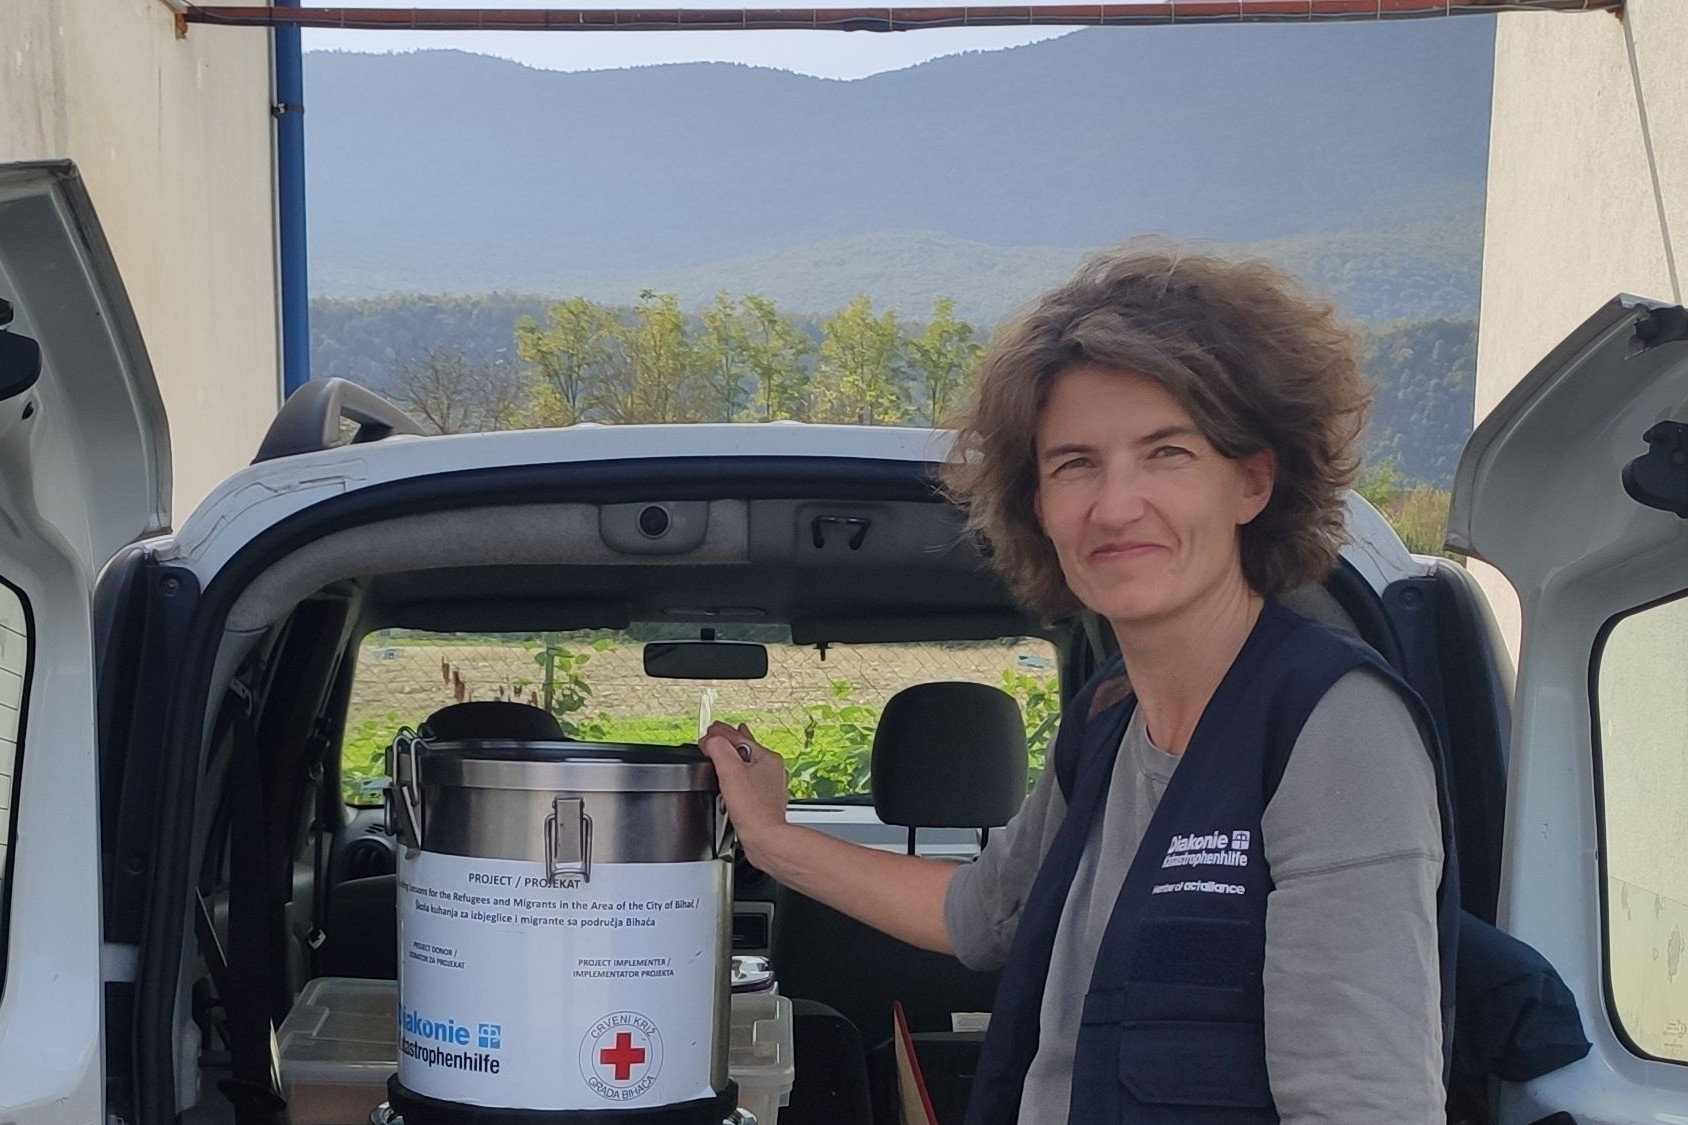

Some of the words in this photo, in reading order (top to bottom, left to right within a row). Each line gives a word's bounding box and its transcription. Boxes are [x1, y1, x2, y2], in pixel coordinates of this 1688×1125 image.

[1167, 830, 1229, 854] Diakonie
[468, 872, 512, 887] PROJECT
[514, 875, 522, 889] /
[524, 877, 581, 890] PROJEKAT
[428, 887, 438, 898] for
[439, 890, 452, 901] the
[453, 892, 491, 906] Refugees
[493, 897, 511, 907] and
[513, 899, 557, 910] Migrants
[559, 901, 569, 910] in
[571, 901, 589, 911] the
[591, 901, 614, 911] Area
[616, 900, 626, 911] of
[628, 900, 644, 911] the
[645, 900, 663, 912] City
[664, 899, 673, 910] of
[430, 904, 459, 919] kuhanja
[460, 908, 469, 919] za
[471, 911, 513, 924] izbjeglice
[521, 915, 565, 927] migrante
[567, 918, 578, 927] sa
[580, 917, 624, 929] područja
[626, 917, 656, 928] Bihaća
[431, 945, 453, 957] DONOR
[573, 970, 640, 979] IMPLEMENTATOR
[641, 969, 674, 978] PROJEKTA
[578, 959, 611, 968] PROJECT
[613, 959, 666, 968] IMPLEMENTER
[398, 1007, 471, 1046] iakonie
[590, 1015, 631, 1039] CRVENI
[633, 1017, 656, 1038] KRIŽ
[588, 1076, 620, 1100] GRADA
